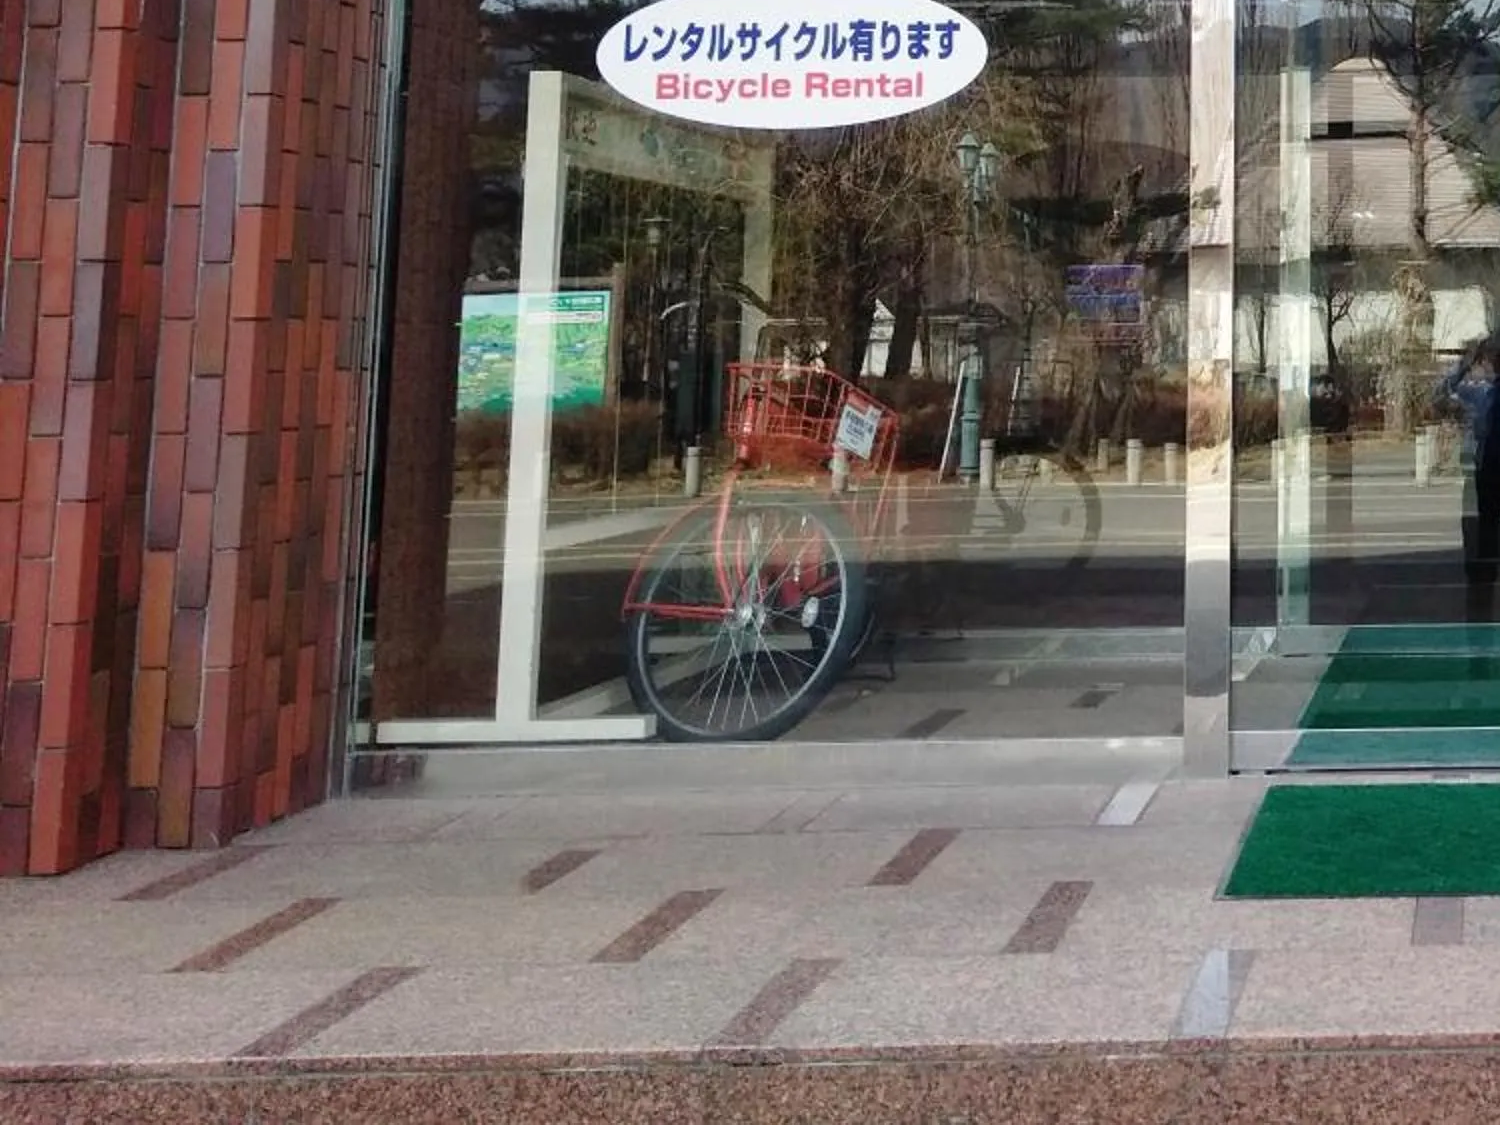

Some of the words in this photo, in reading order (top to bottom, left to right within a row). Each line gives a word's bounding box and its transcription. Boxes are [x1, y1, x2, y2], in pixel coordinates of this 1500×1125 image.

[623, 19, 961, 63] レンタルサイクル有ります
[655, 73, 791, 103] Bicycle
[804, 72, 923, 99] Rental
